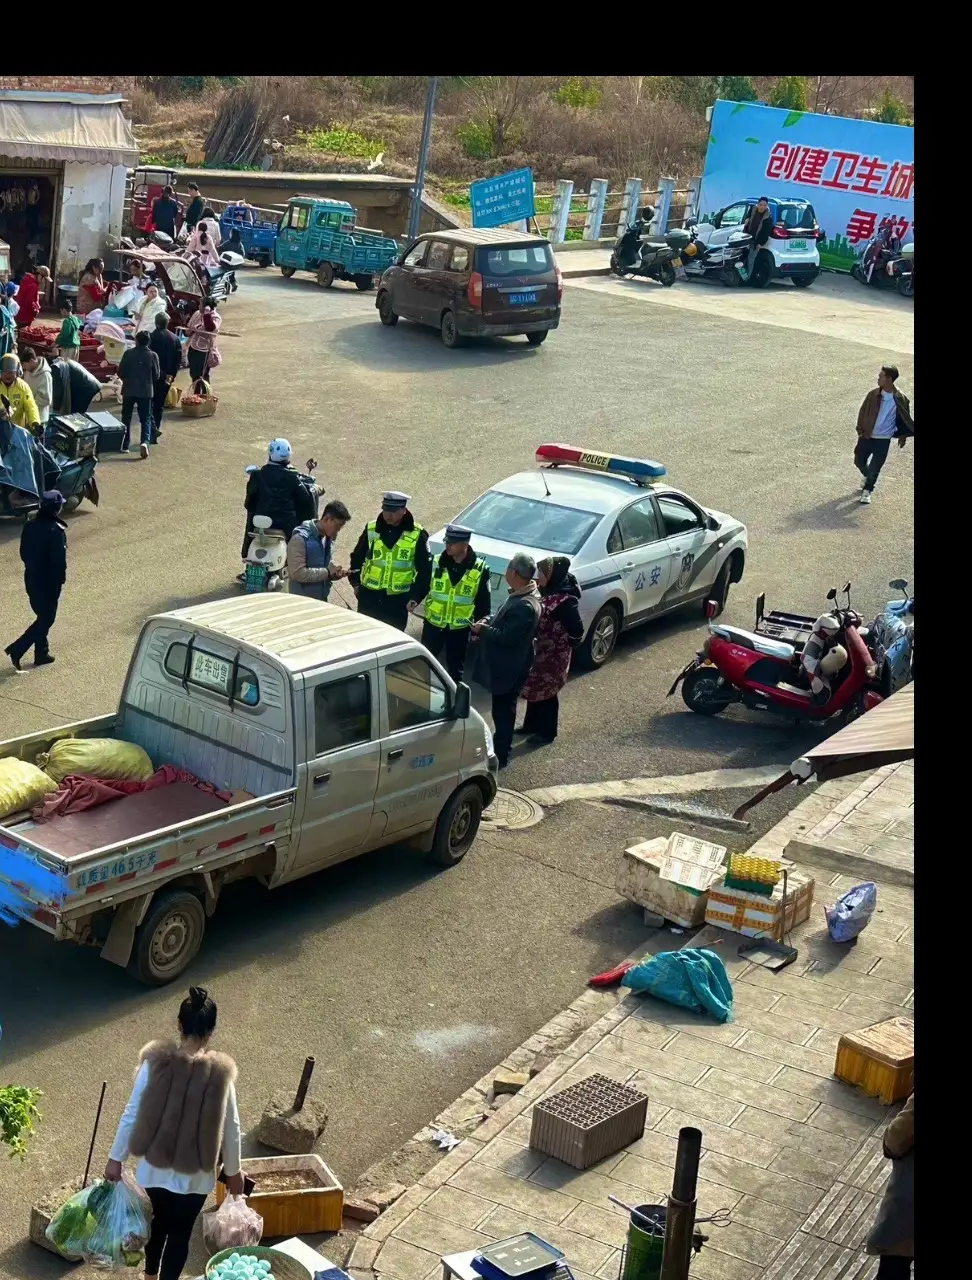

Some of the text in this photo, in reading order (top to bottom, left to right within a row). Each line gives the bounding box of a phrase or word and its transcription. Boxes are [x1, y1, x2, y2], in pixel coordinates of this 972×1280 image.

[581, 453, 608, 466] POLICE
[634, 565, 662, 592] 公安
[195, 654, 228, 684] 此车出售
